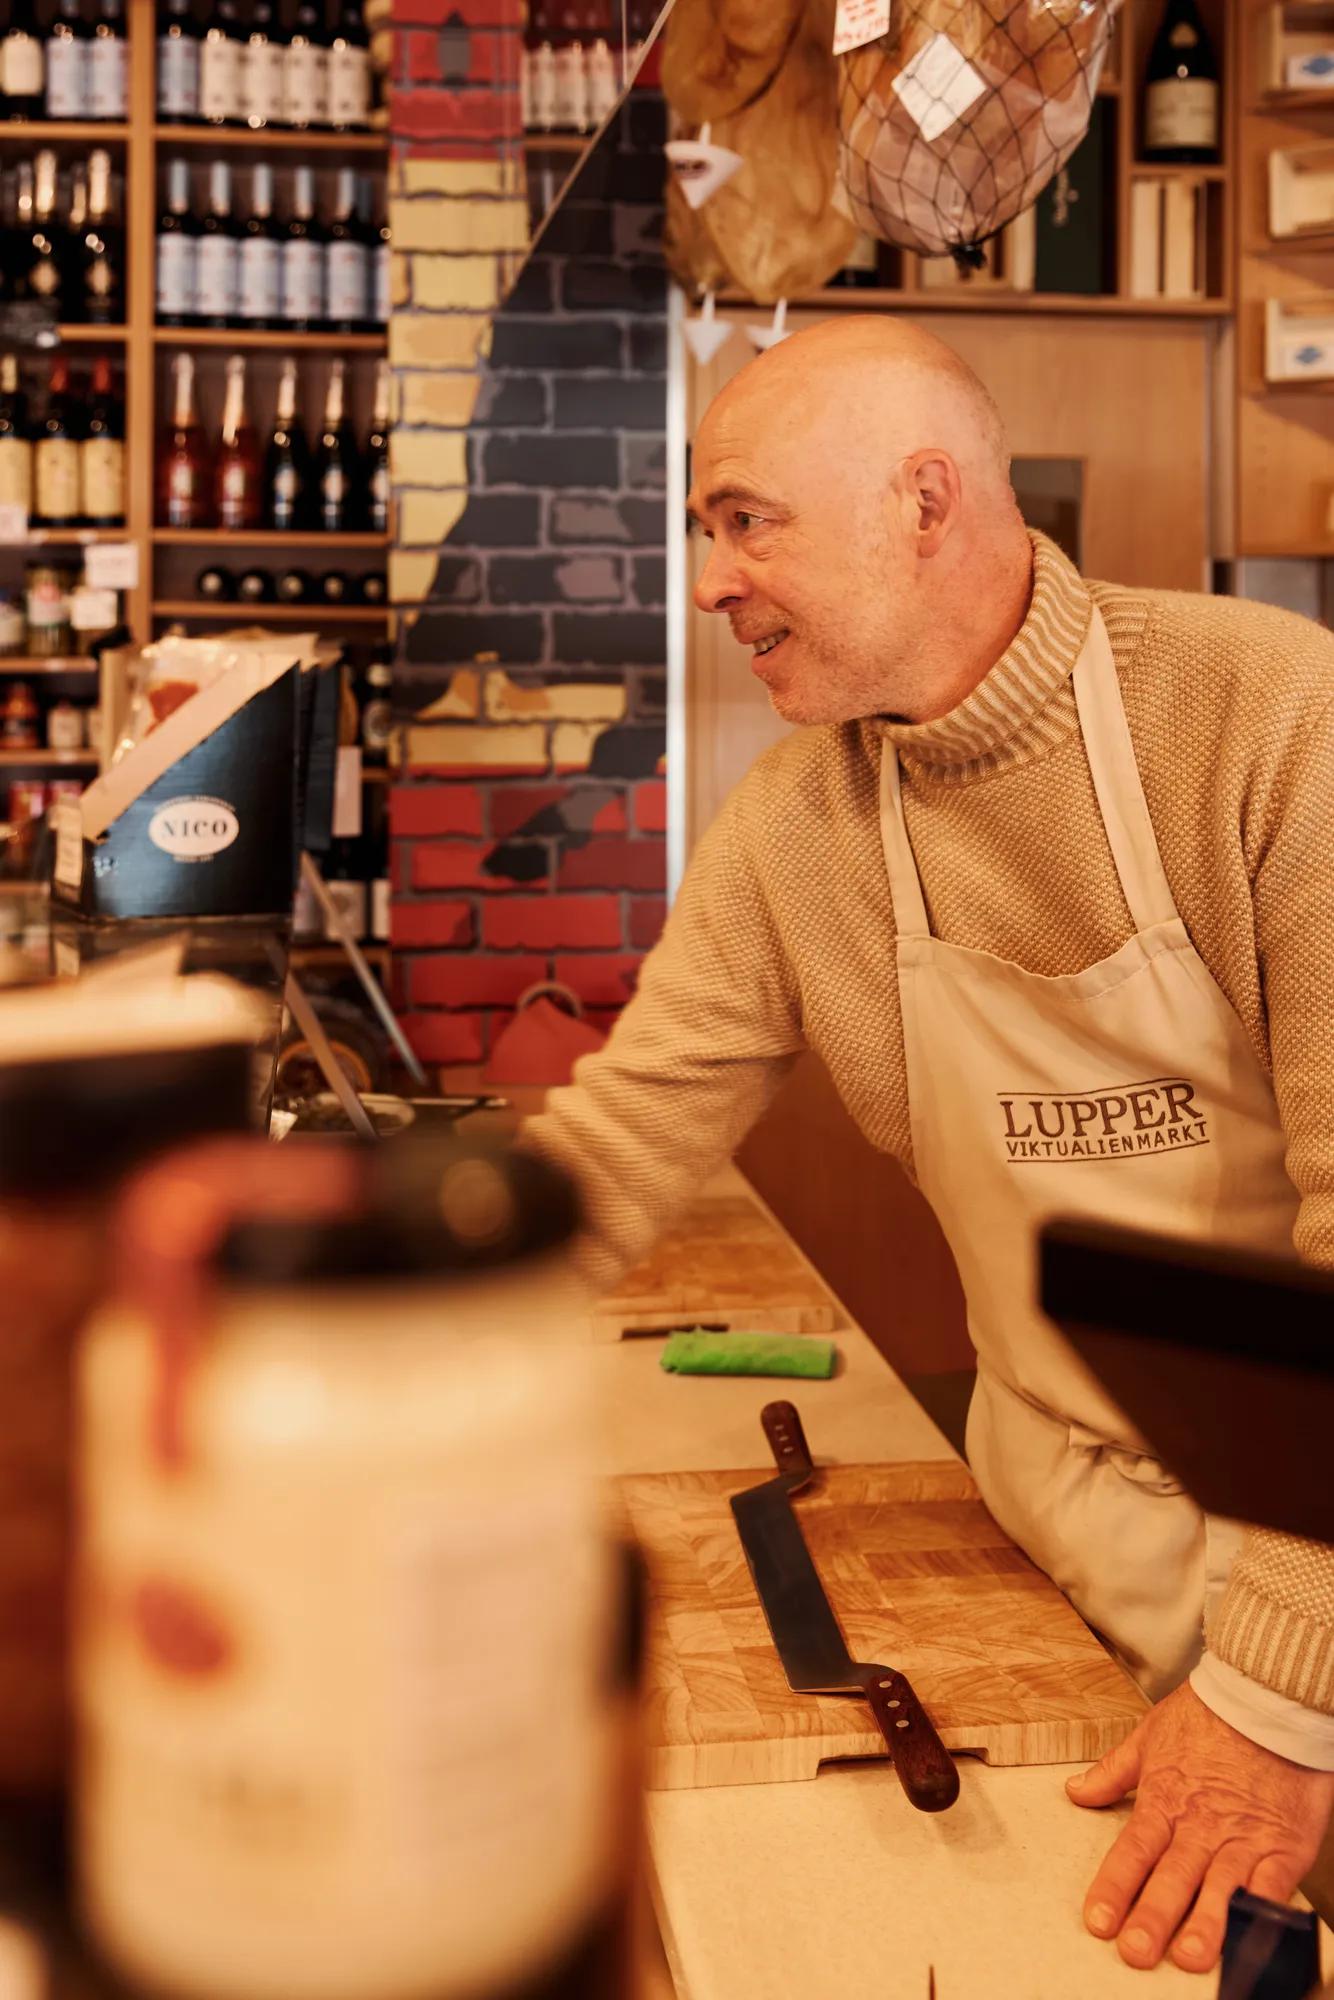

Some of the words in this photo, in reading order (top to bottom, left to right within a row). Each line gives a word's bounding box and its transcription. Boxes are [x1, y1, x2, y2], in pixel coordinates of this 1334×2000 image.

[161, 819, 228, 838] NICO
[999, 1082, 1204, 1139] LUPPER
[1006, 1121, 1208, 1157] VIKTUALIENMARKT
